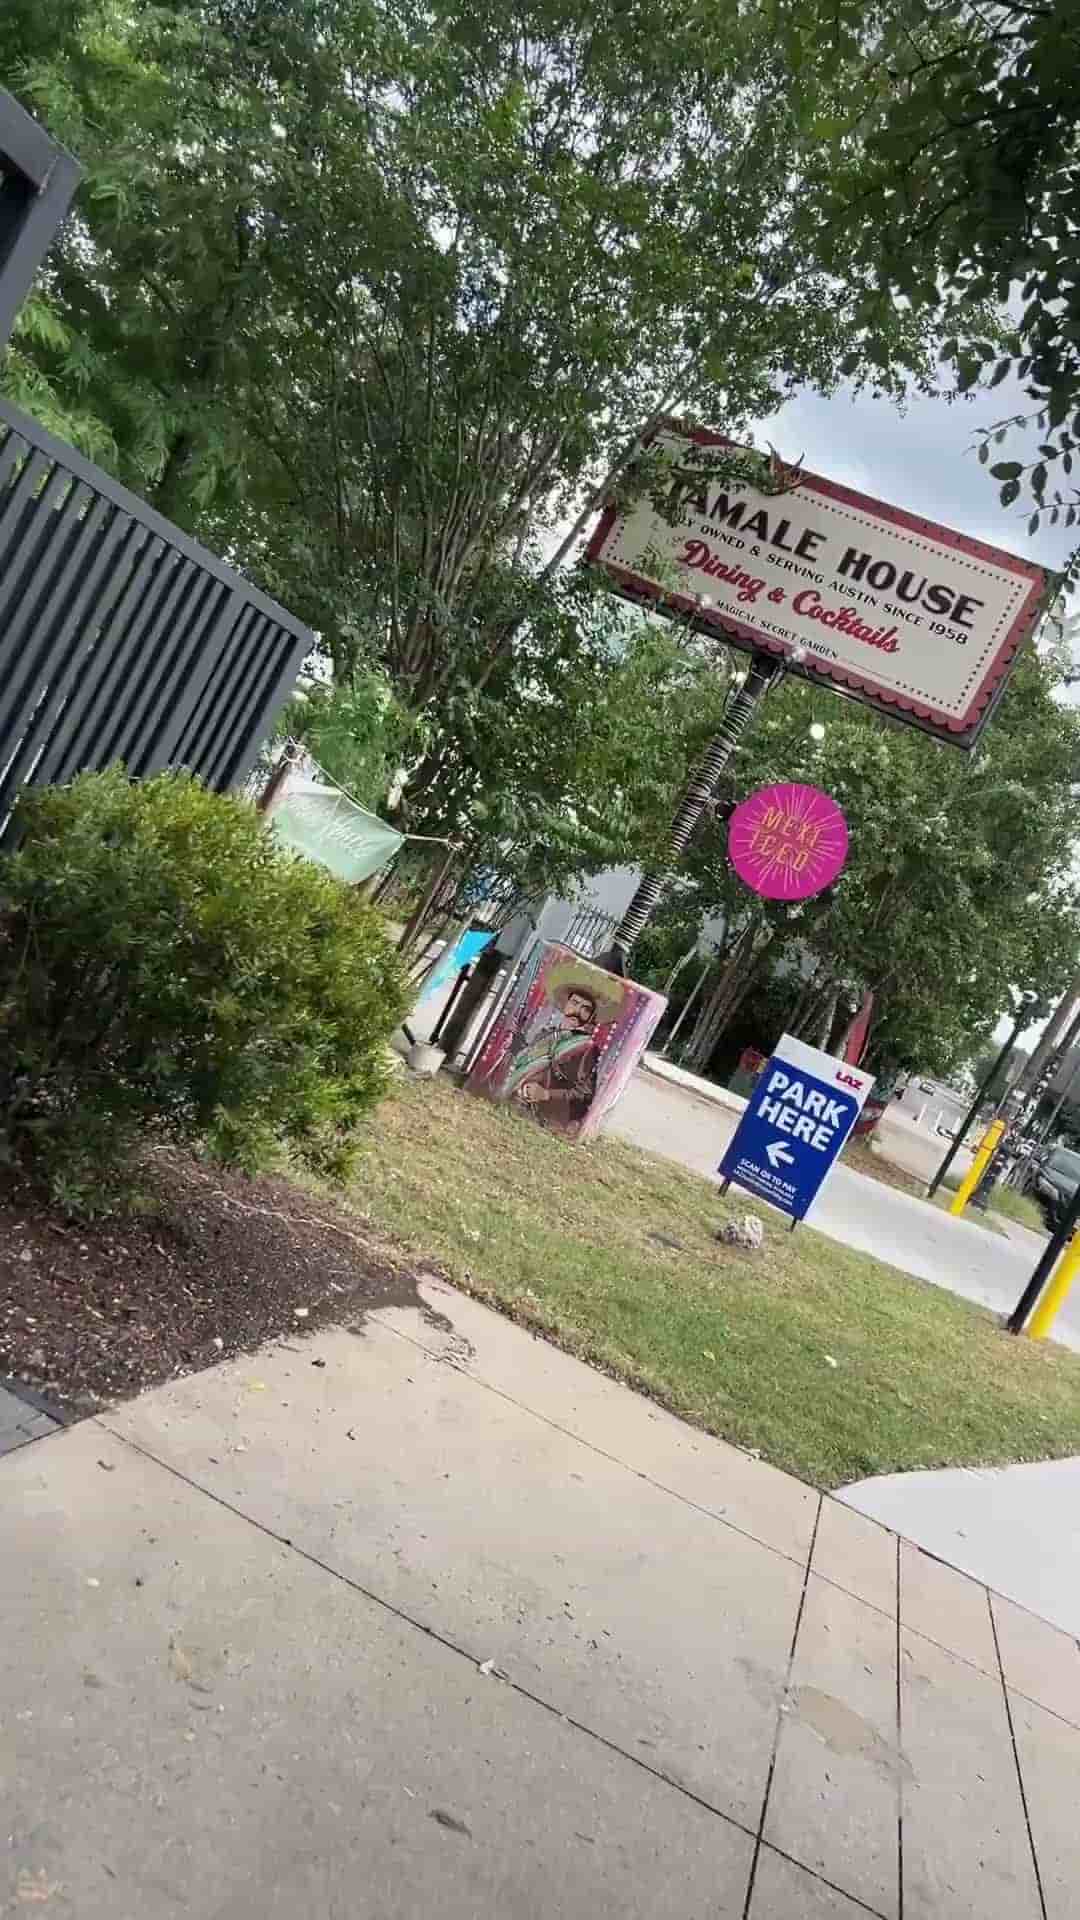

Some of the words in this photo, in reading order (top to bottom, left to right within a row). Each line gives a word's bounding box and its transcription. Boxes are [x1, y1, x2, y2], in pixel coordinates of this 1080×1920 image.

[677, 539, 767, 603] Dining
[767, 586, 787, 604] &
[792, 589, 900, 653] Cocktails
[700, 524, 745, 550] OWNED
[749, 545, 761, 557] &
[767, 552, 825, 584] SERVING
[828, 580, 879, 607] AUSTIN
[882, 603, 925, 627] SINCE
[928, 621, 969, 645] 1958
[836, 547, 985, 629] HOUSE
[716, 599, 756, 624] MAGICAL
[759, 620, 798, 641] SECRET
[799, 638, 839, 659] GARDEN
[756, 1095, 835, 1152] HERE
[767, 1070, 848, 1129] PARK
[739, 1158, 760, 1174] SCAN
